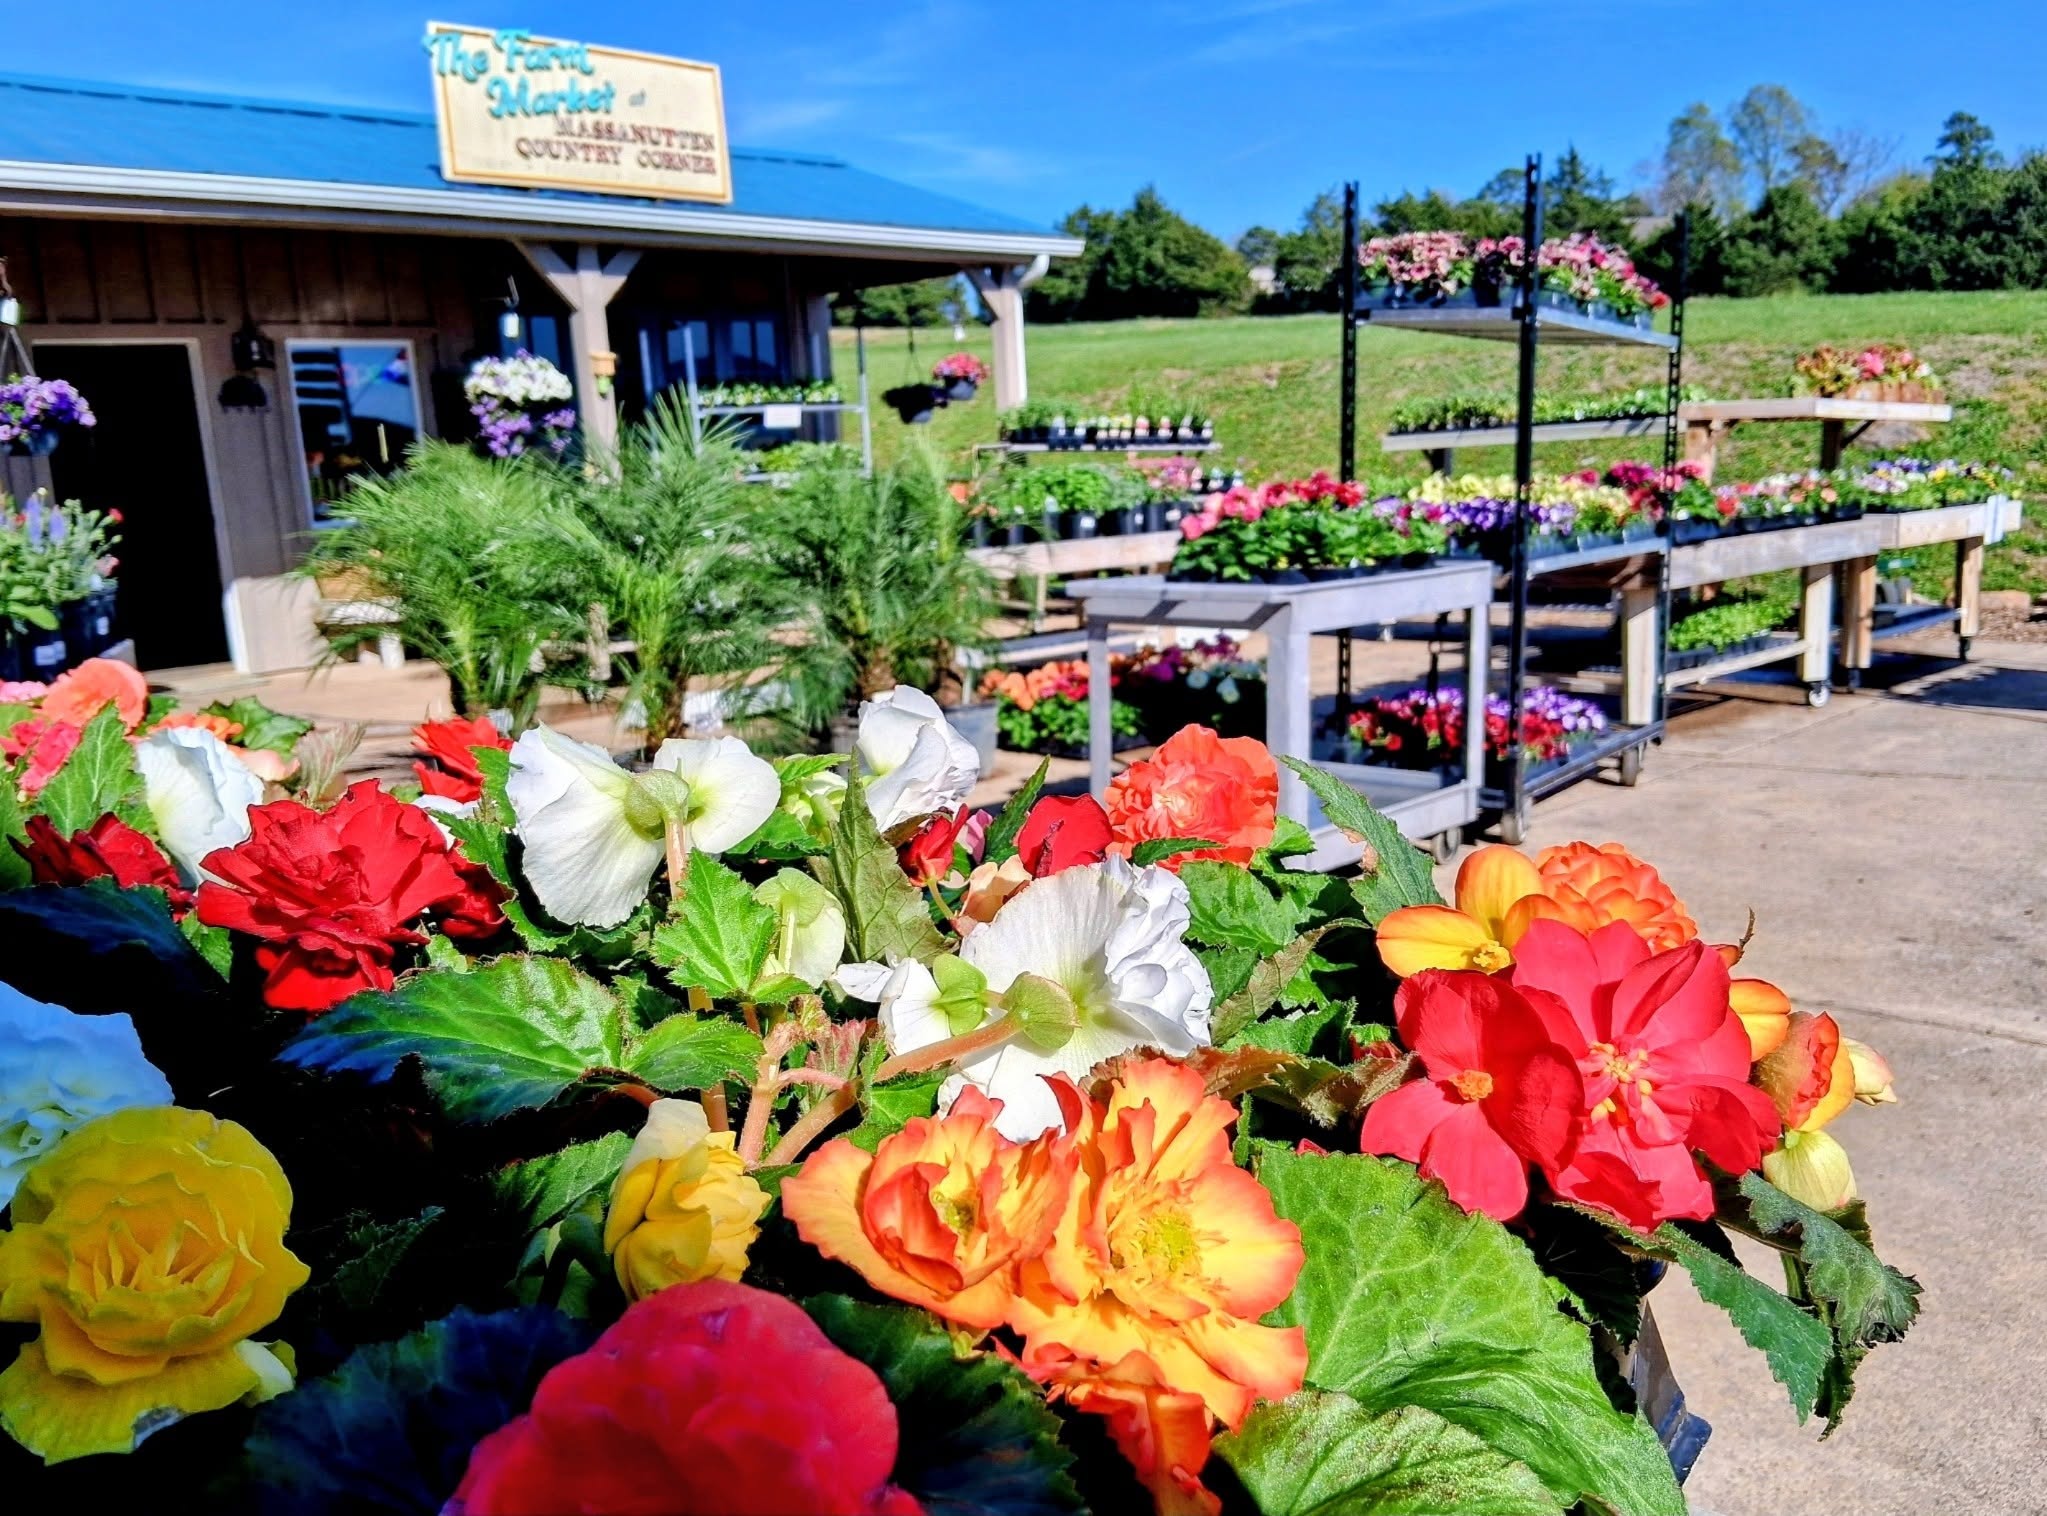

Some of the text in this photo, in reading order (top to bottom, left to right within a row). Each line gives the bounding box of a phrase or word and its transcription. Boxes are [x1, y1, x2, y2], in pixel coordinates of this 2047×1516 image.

[423, 28, 594, 83] The Farm
[486, 76, 647, 118] Market at
[555, 116, 715, 151] MASSANUTTEN
[515, 137, 717, 175] COUNTRY CORNER
